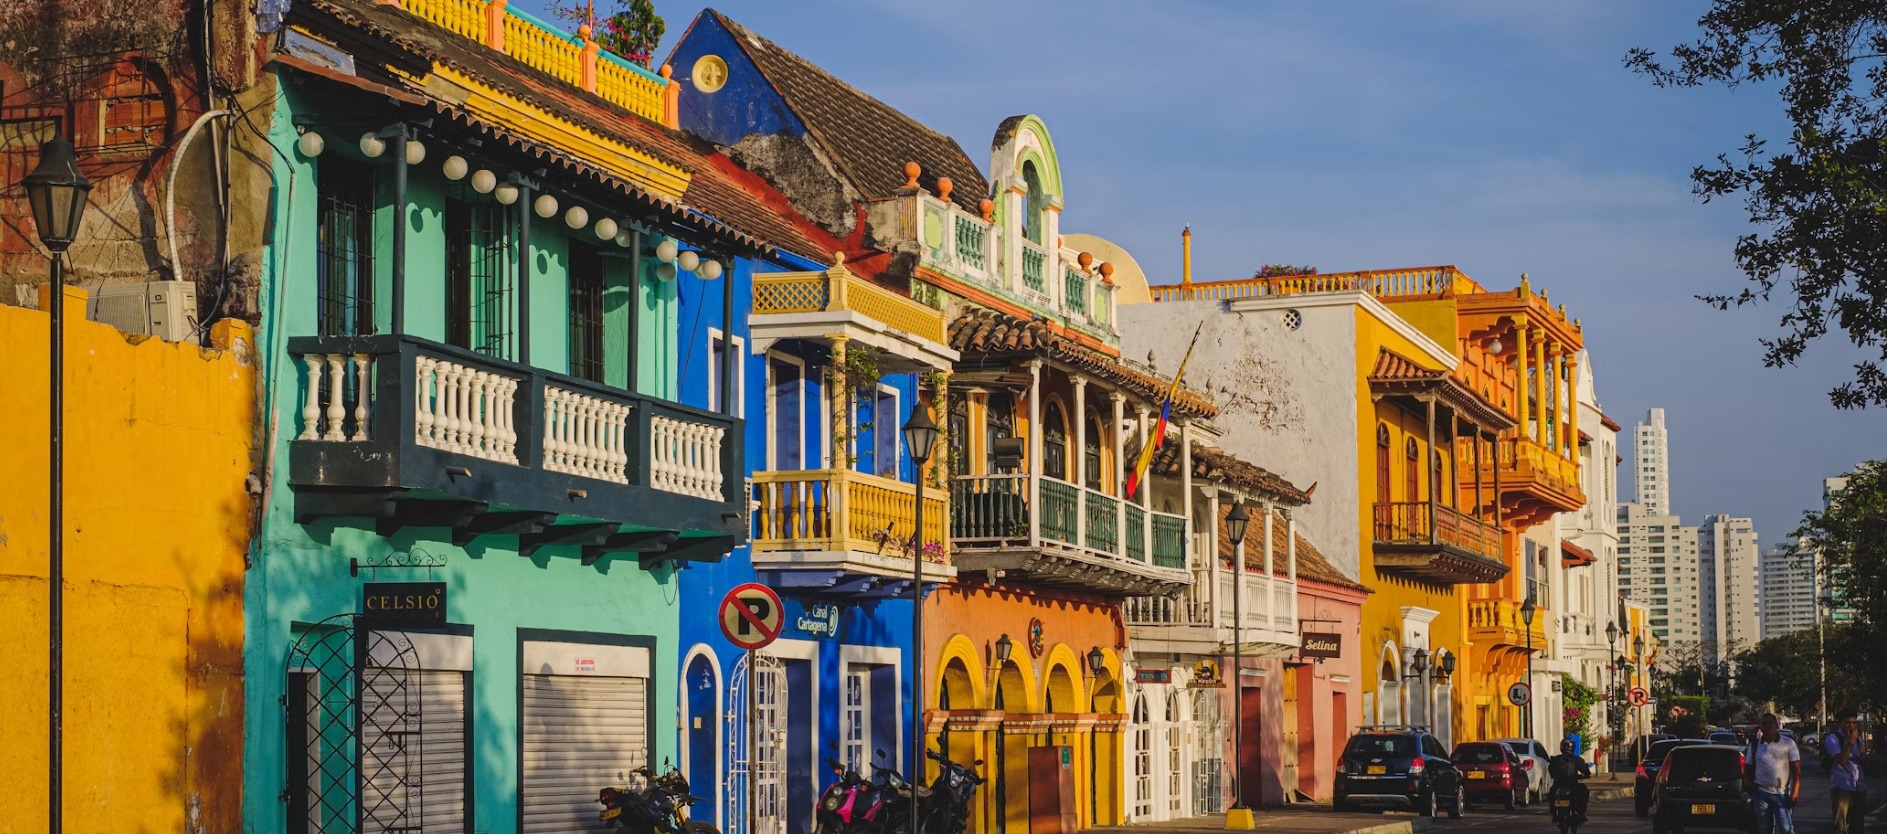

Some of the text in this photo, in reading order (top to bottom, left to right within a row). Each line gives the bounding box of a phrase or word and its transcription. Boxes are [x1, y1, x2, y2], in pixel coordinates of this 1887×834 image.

[738, 597, 770, 635] P
[812, 604, 828, 619] Canal
[798, 616, 828, 634] Cartagena
[1305, 639, 1338, 651] Selina
